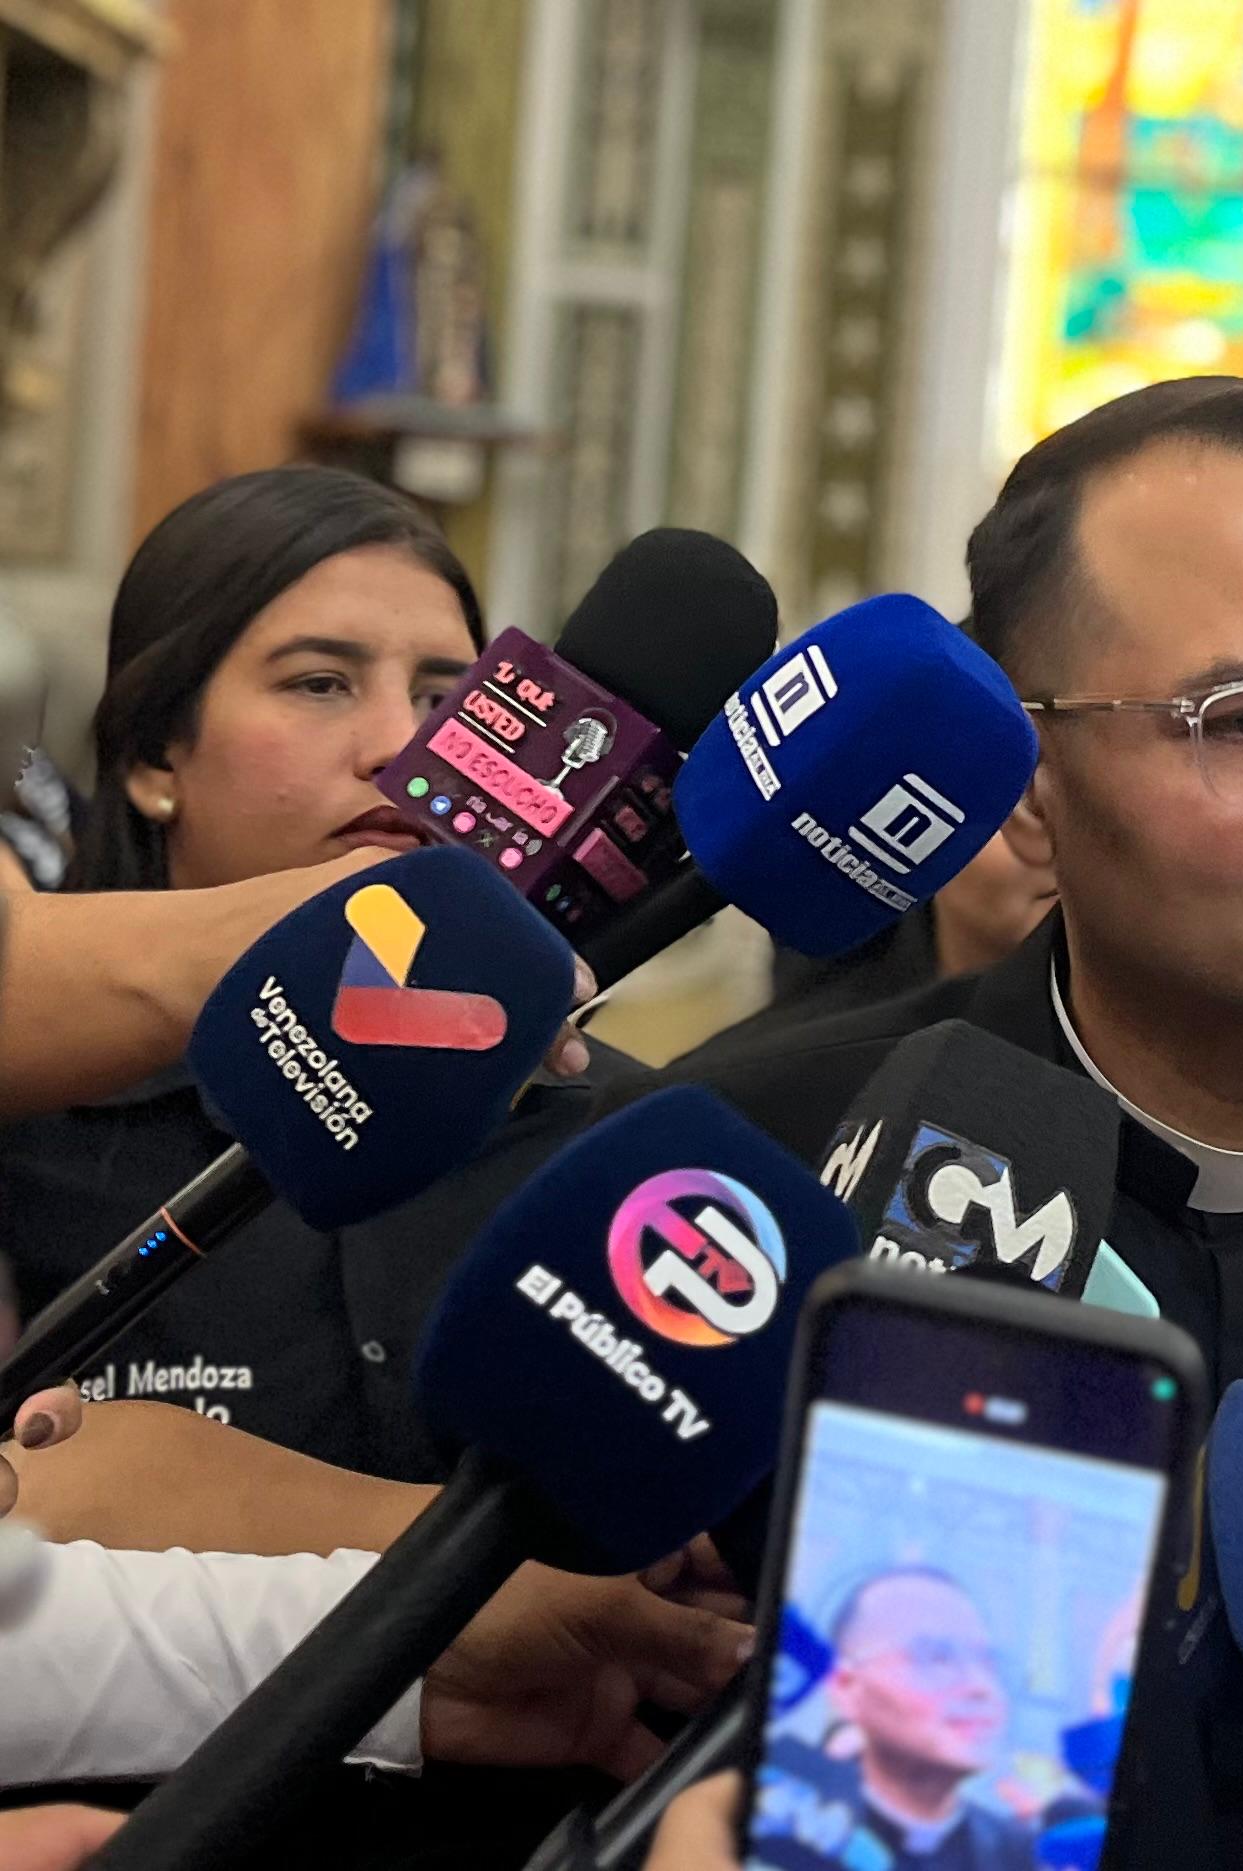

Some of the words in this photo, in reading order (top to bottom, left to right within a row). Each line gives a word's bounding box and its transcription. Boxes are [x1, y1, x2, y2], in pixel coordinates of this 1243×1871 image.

[259, 975, 374, 1124] Venezolana
[259, 1020, 359, 1150] Televisión
[128, 1355, 254, 1396] Mendoza
[516, 1264, 562, 1305] El
[549, 1291, 666, 1401] Público
[661, 1388, 710, 1440] TV
